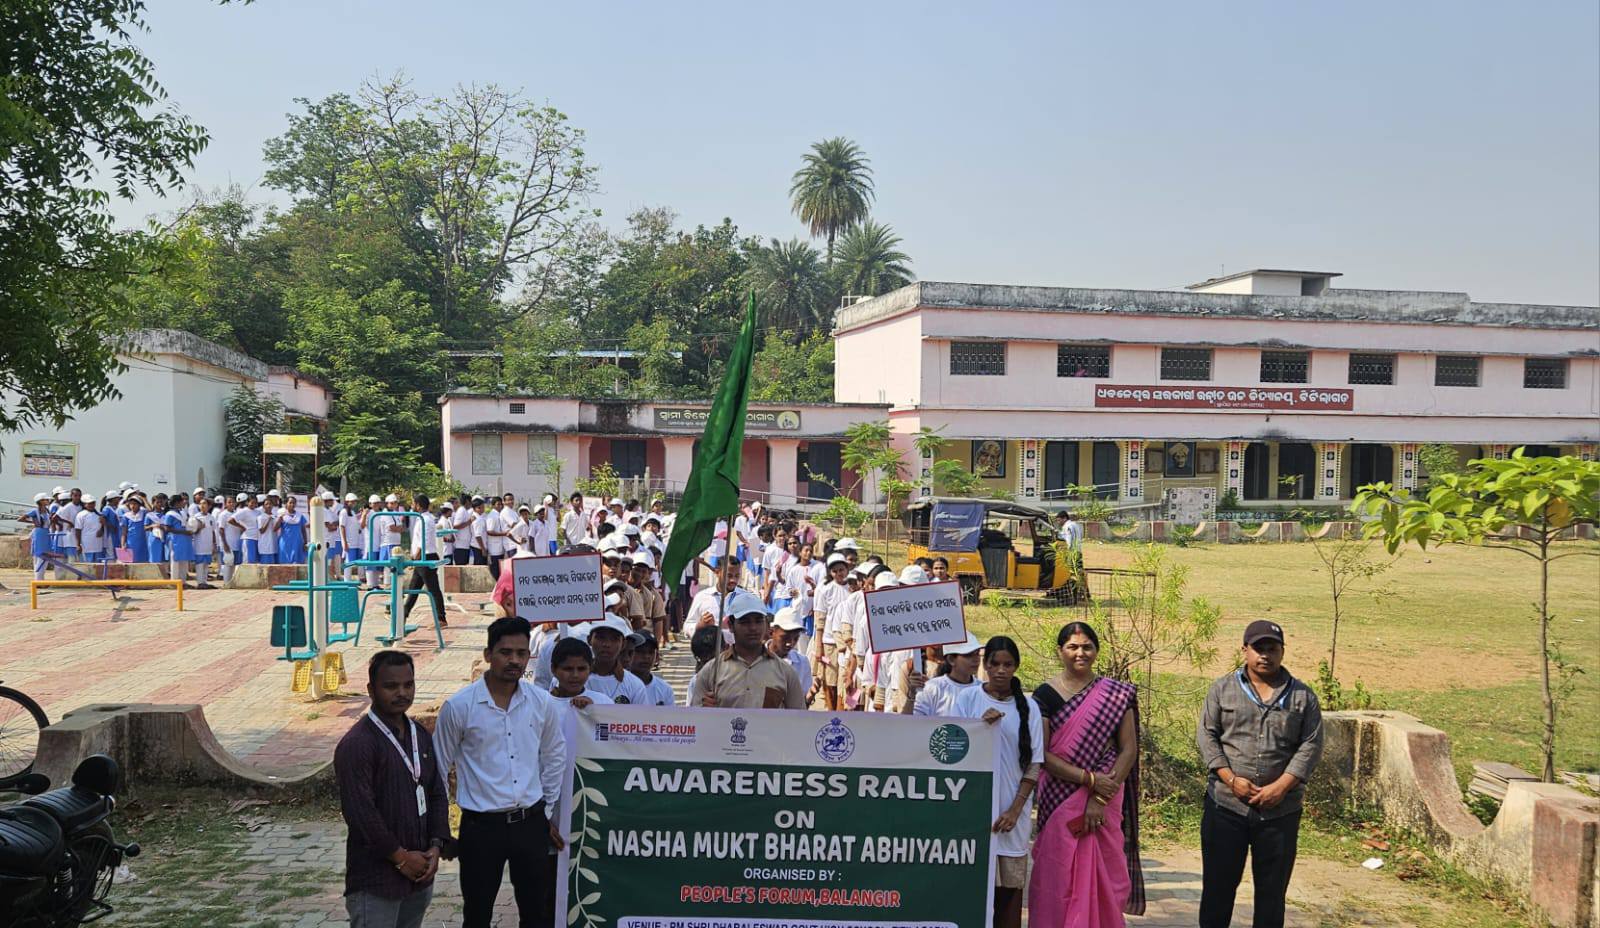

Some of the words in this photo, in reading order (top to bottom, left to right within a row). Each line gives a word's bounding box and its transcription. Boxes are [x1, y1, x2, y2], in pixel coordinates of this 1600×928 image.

[1152, 389, 1194, 401] ସରକାରୀ
[609, 723, 657, 734] PEOPLE'S
[660, 725, 696, 735] FORUM
[624, 767, 848, 797] AWARENESS
[857, 774, 968, 801] RALLY
[774, 809, 815, 830] ON
[607, 830, 687, 858] NASHA
[693, 831, 759, 859] MUKT
[765, 833, 856, 862] BHARAT
[860, 837, 976, 865] ABHIYAAN
[743, 867, 816, 881] ORGANISED
[819, 869, 836, 882] BY
[680, 885, 755, 903] PEOPLE'S
[758, 887, 900, 907] FORUM,BALANGIR
